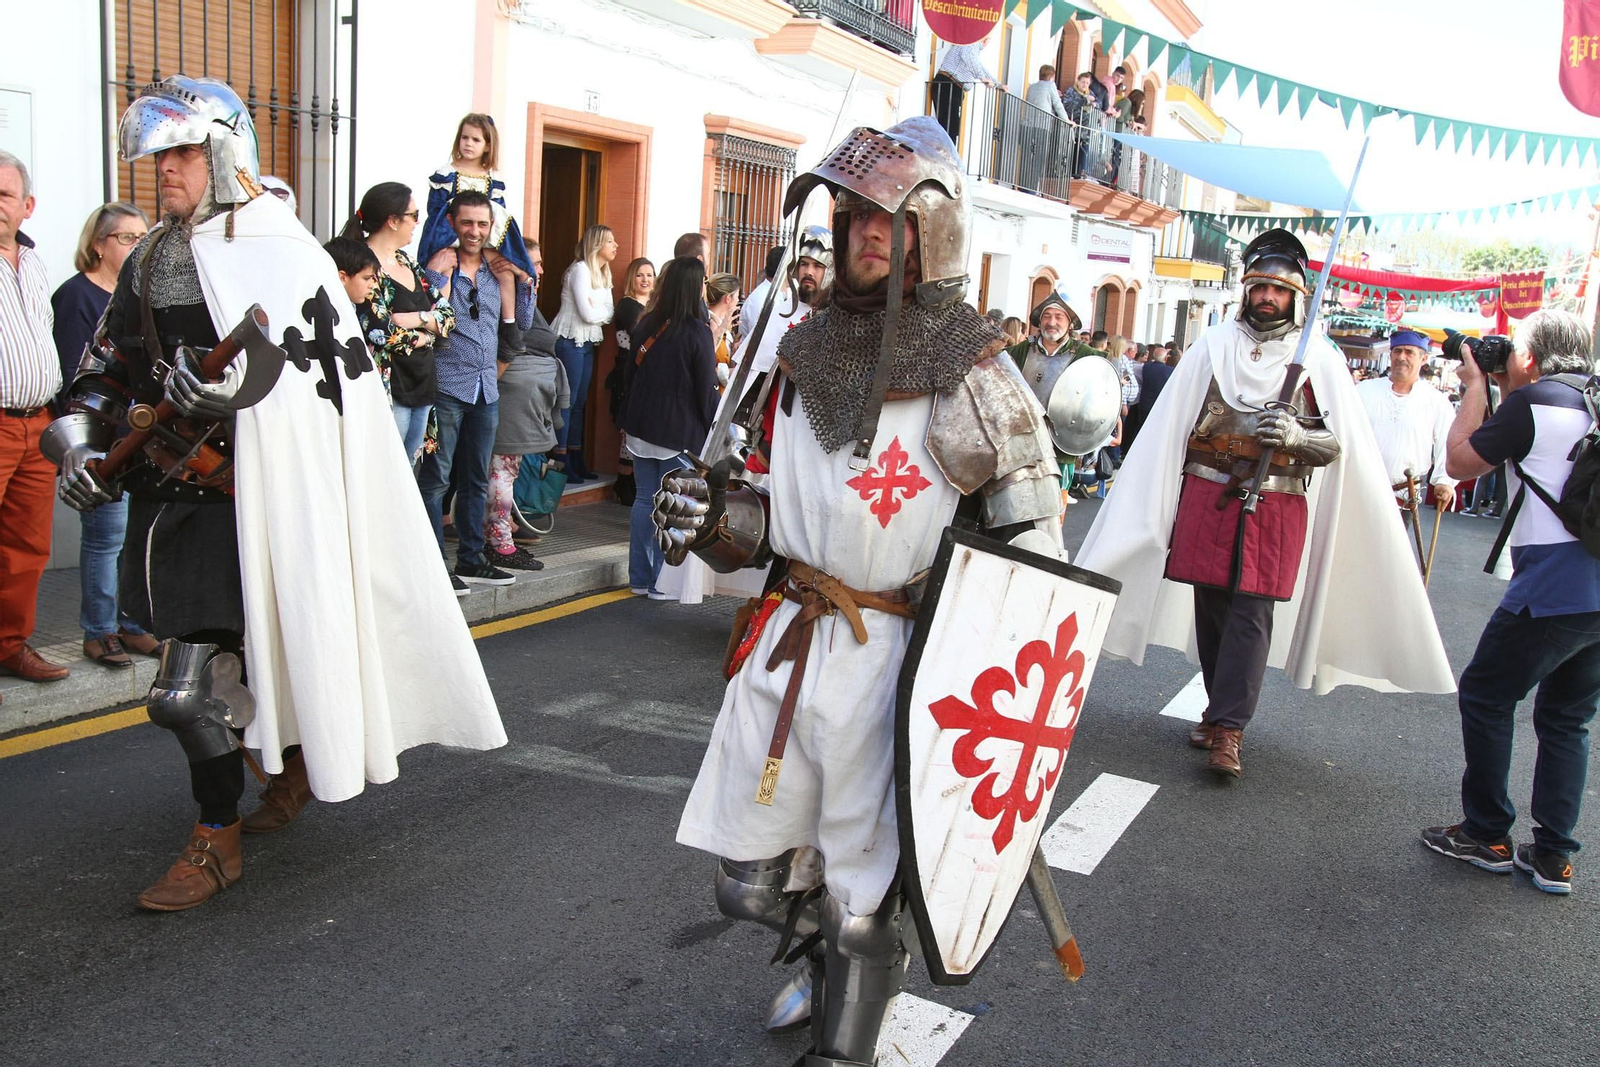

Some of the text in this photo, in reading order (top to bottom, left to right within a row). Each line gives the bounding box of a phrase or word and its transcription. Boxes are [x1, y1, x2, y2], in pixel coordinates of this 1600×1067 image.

[924, 0, 999, 22] Descubrimiento
[1568, 35, 1600, 67] Pi
[1101, 237, 1130, 246] DENTAL
